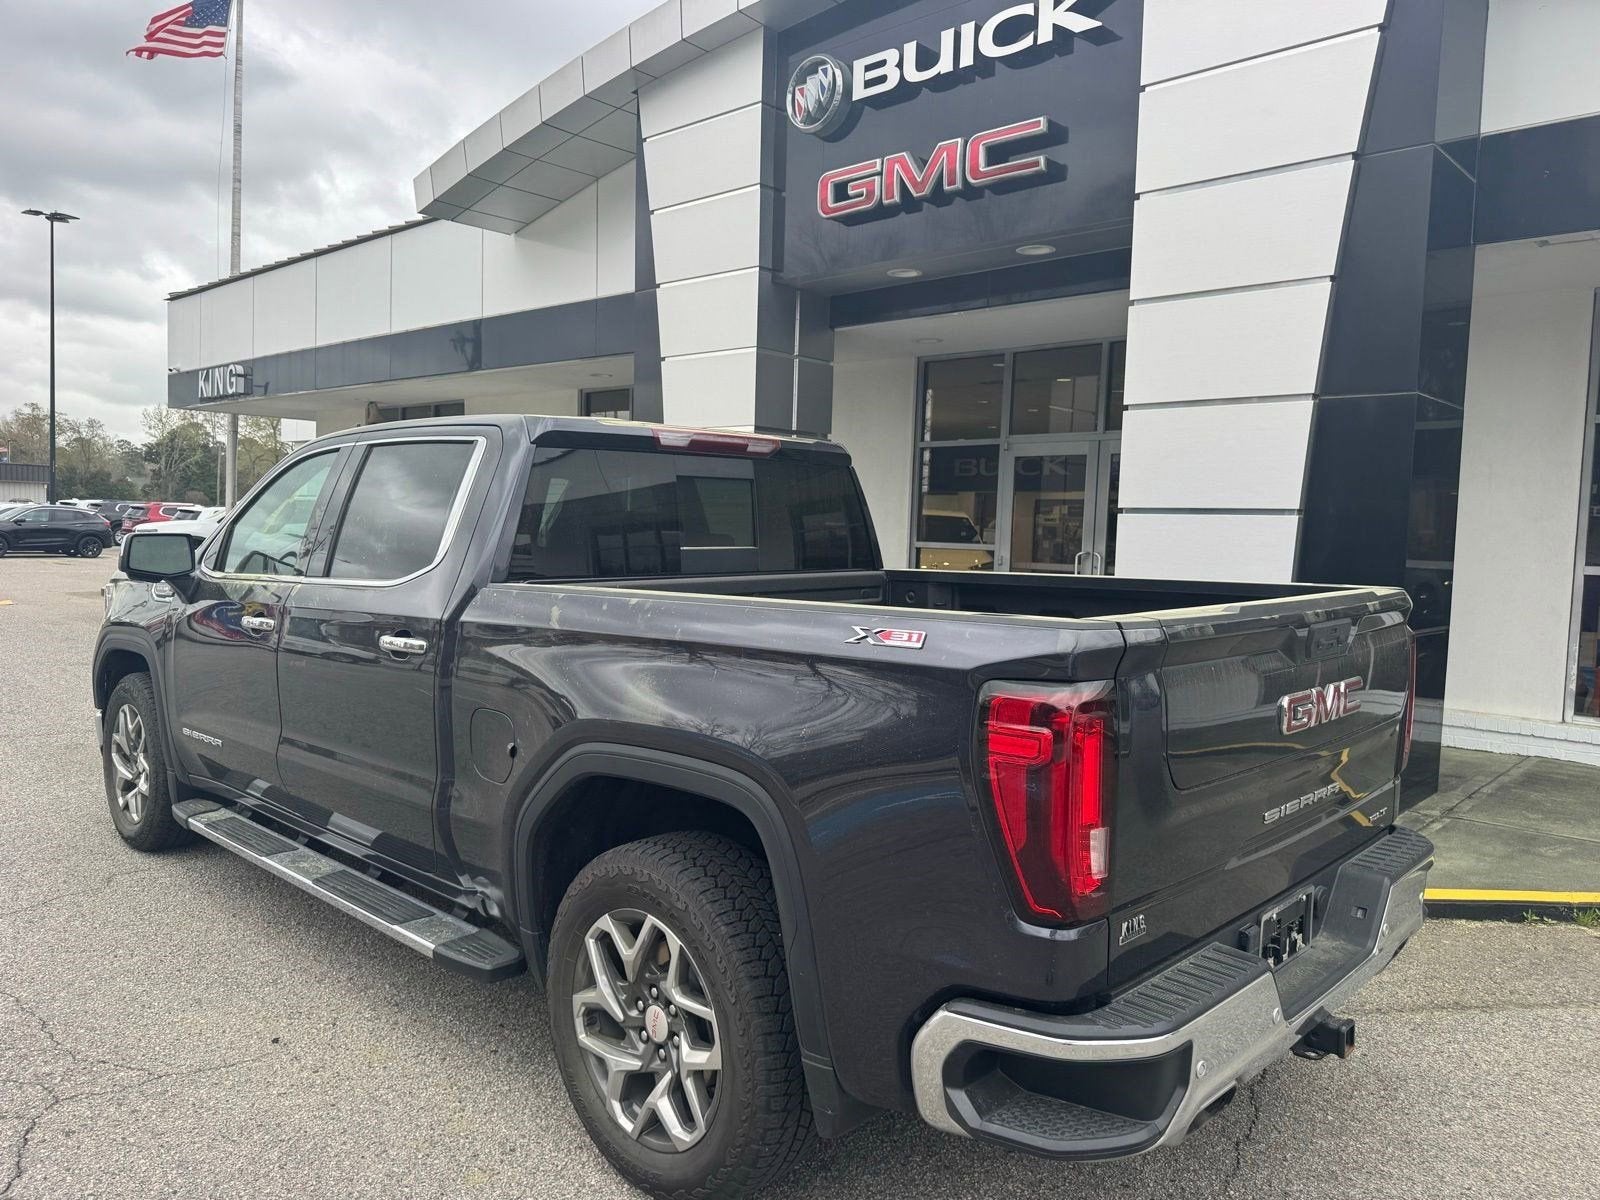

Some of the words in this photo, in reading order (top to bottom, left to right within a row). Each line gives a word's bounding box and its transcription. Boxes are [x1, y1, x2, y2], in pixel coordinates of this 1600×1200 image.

[852, 0, 1102, 101] BUICK
[818, 115, 1047, 219] GMC
[198, 363, 239, 398] KING
[953, 456, 1072, 477] BUCK
[844, 625, 927, 649] X31
[1279, 676, 1363, 735] GMC
[182, 727, 223, 747] SIERRA
[1263, 782, 1340, 824] SIERRA
[1121, 914, 1145, 938] KING
